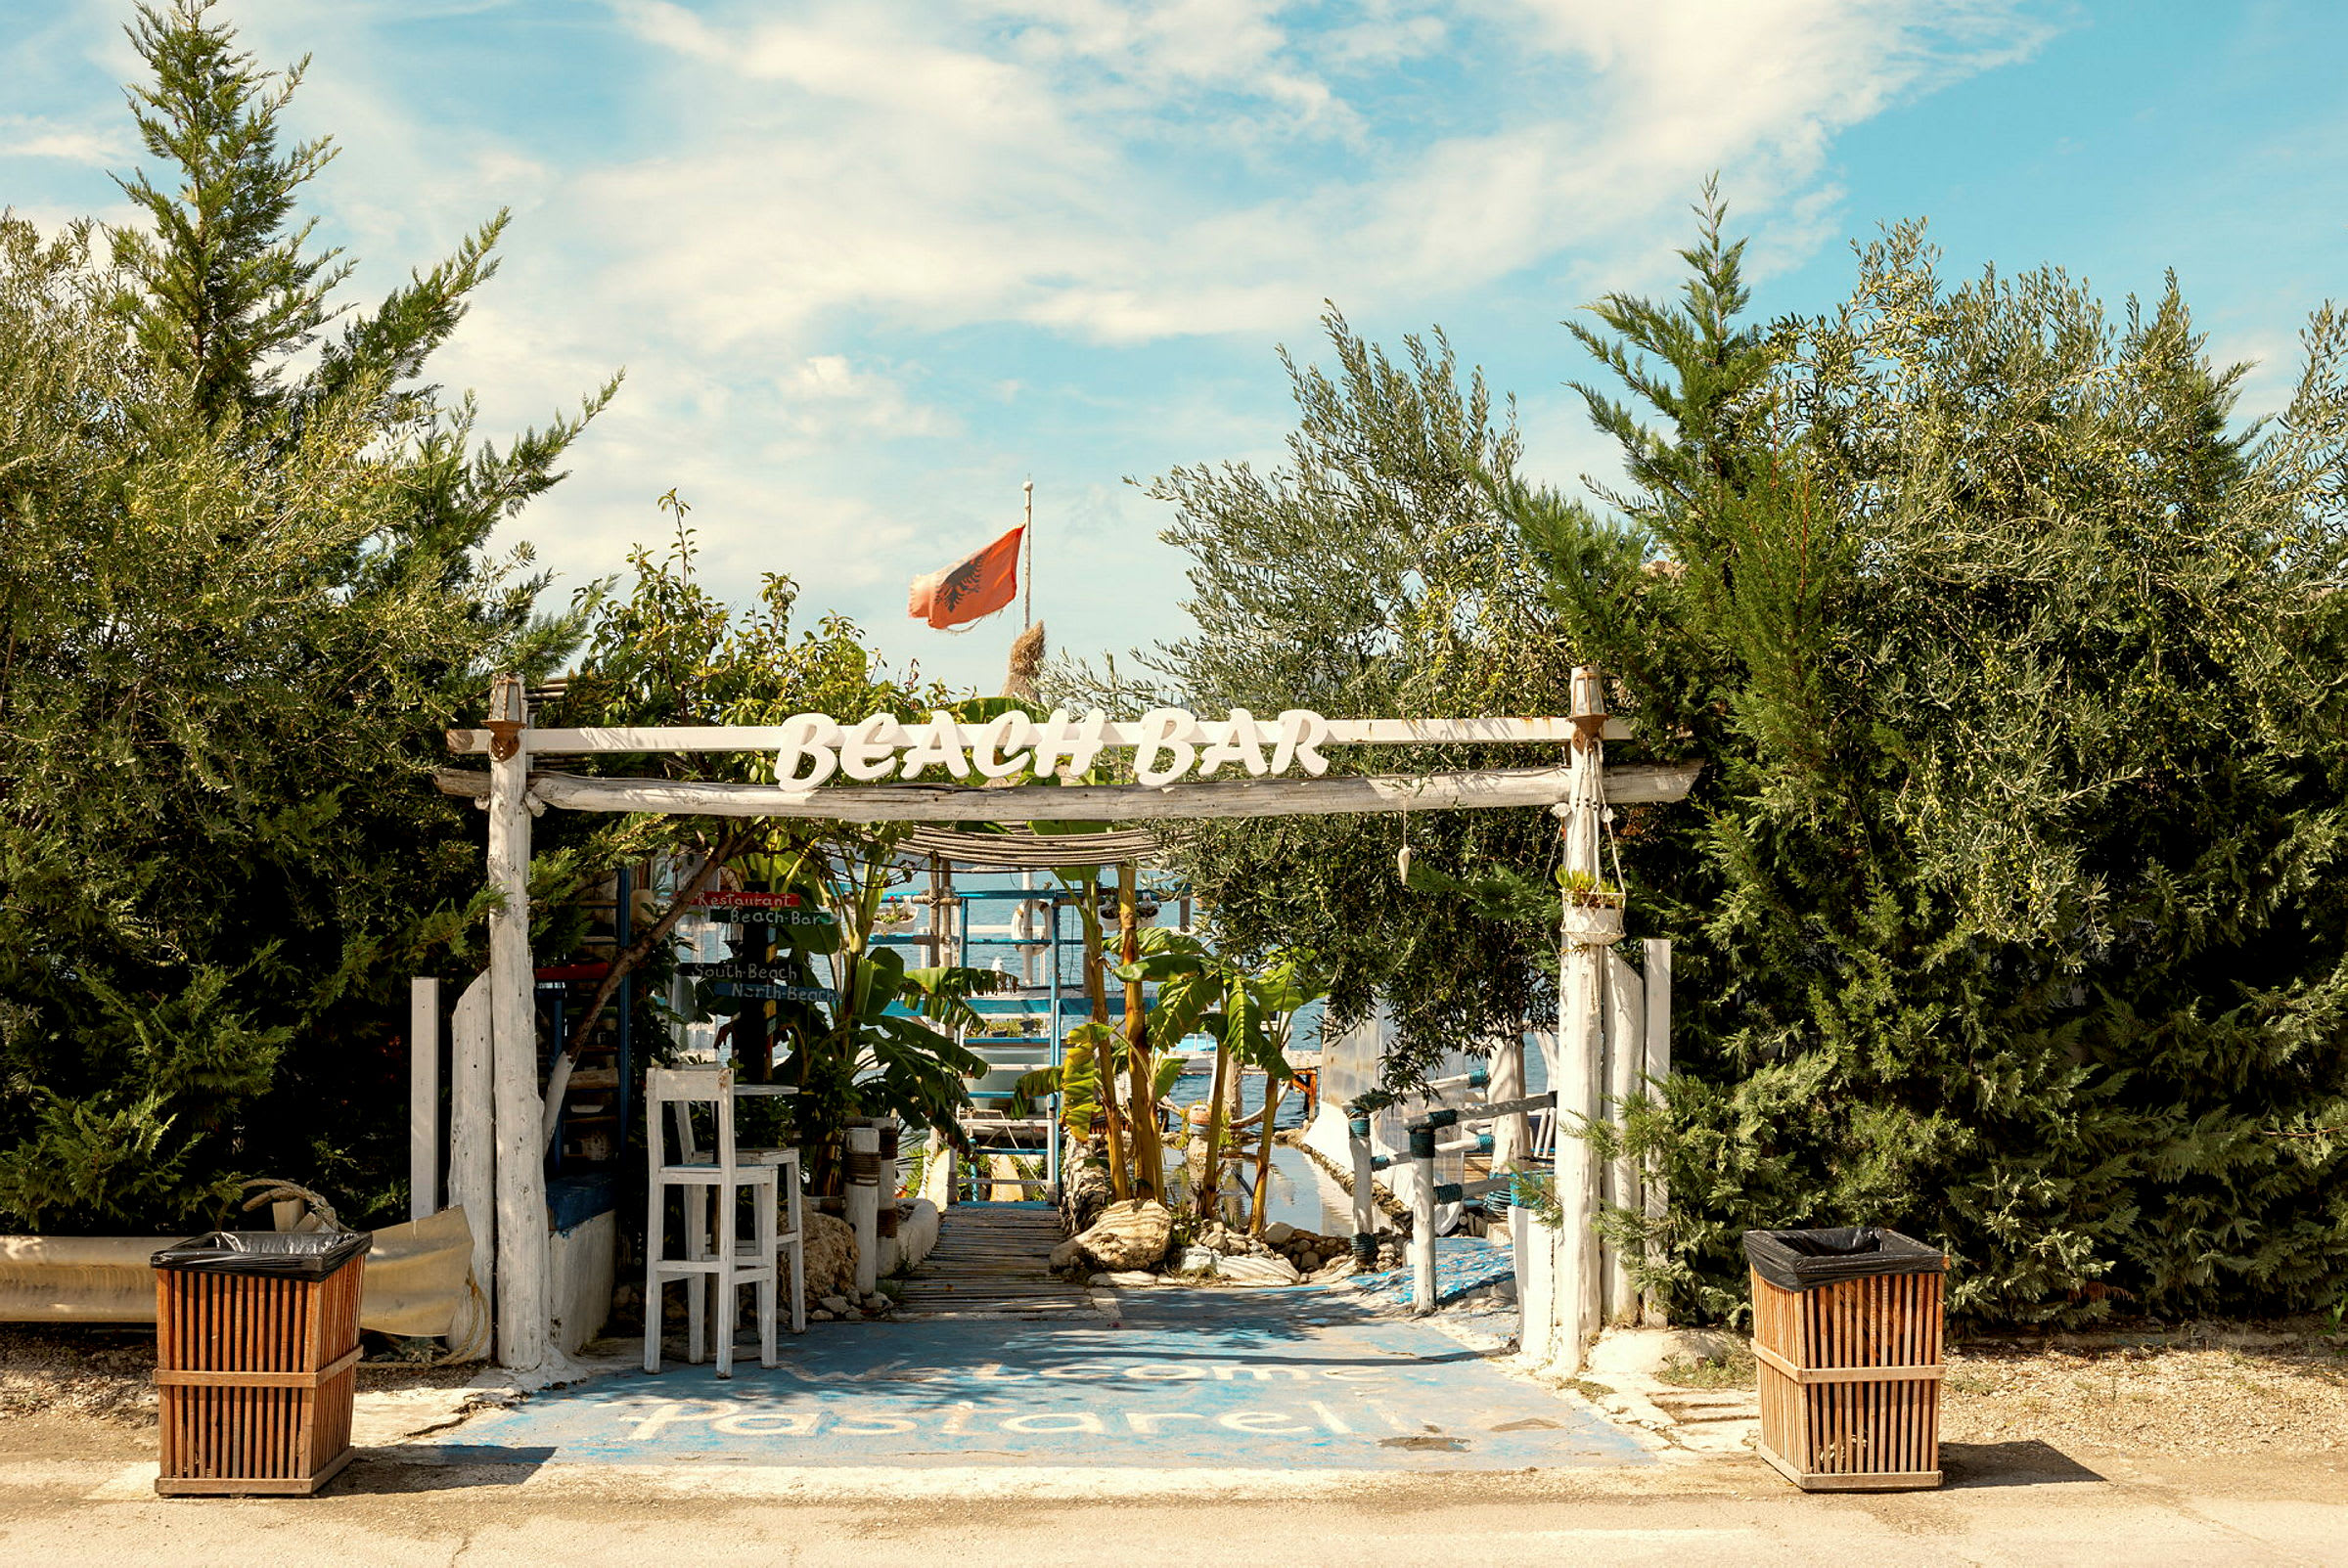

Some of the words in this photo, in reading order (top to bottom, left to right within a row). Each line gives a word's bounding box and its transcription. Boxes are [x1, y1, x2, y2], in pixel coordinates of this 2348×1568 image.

[773, 709, 1106, 793] BEACH
[1133, 707, 1331, 786] BAR
[698, 892, 791, 907] Restaurant
